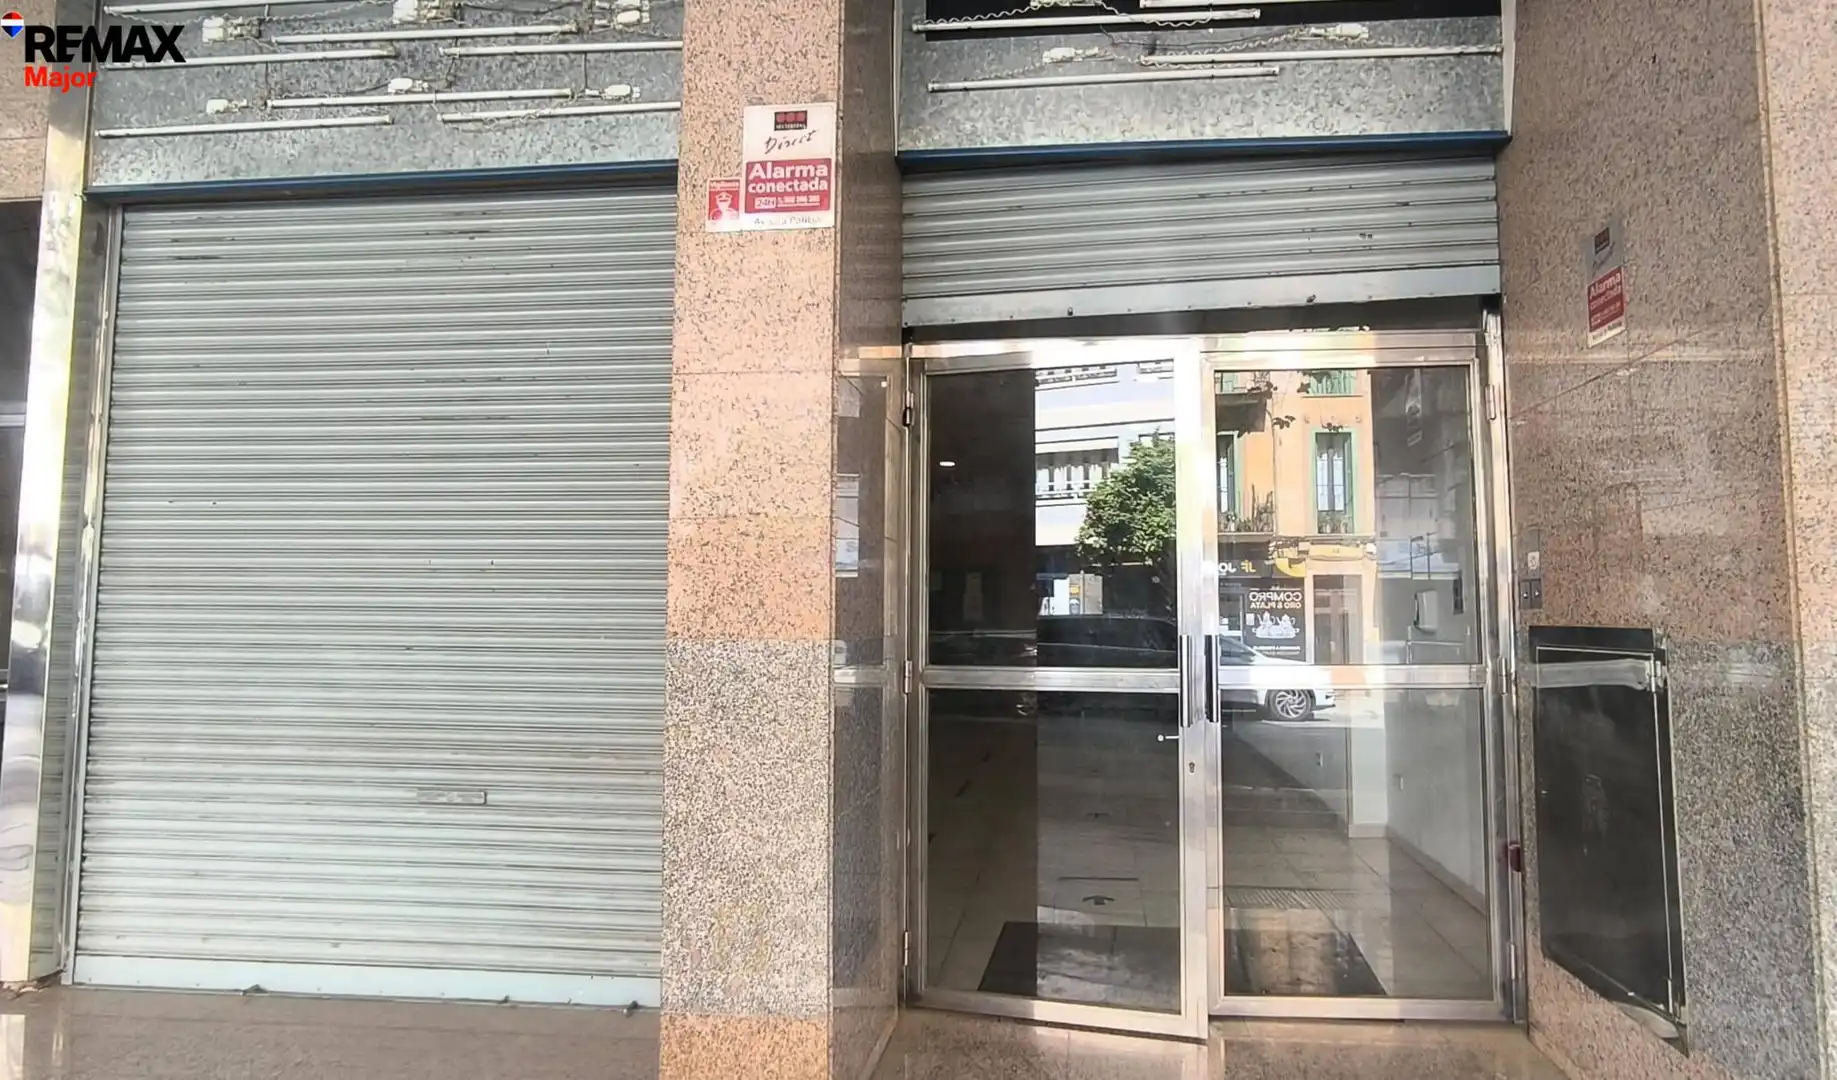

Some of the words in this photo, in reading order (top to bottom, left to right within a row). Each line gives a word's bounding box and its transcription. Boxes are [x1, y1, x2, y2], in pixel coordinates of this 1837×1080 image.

[764, 130, 817, 154] Direct
[748, 161, 828, 180] Alarma
[747, 177, 829, 193] conectada
[1589, 272, 1621, 301] Alarma
